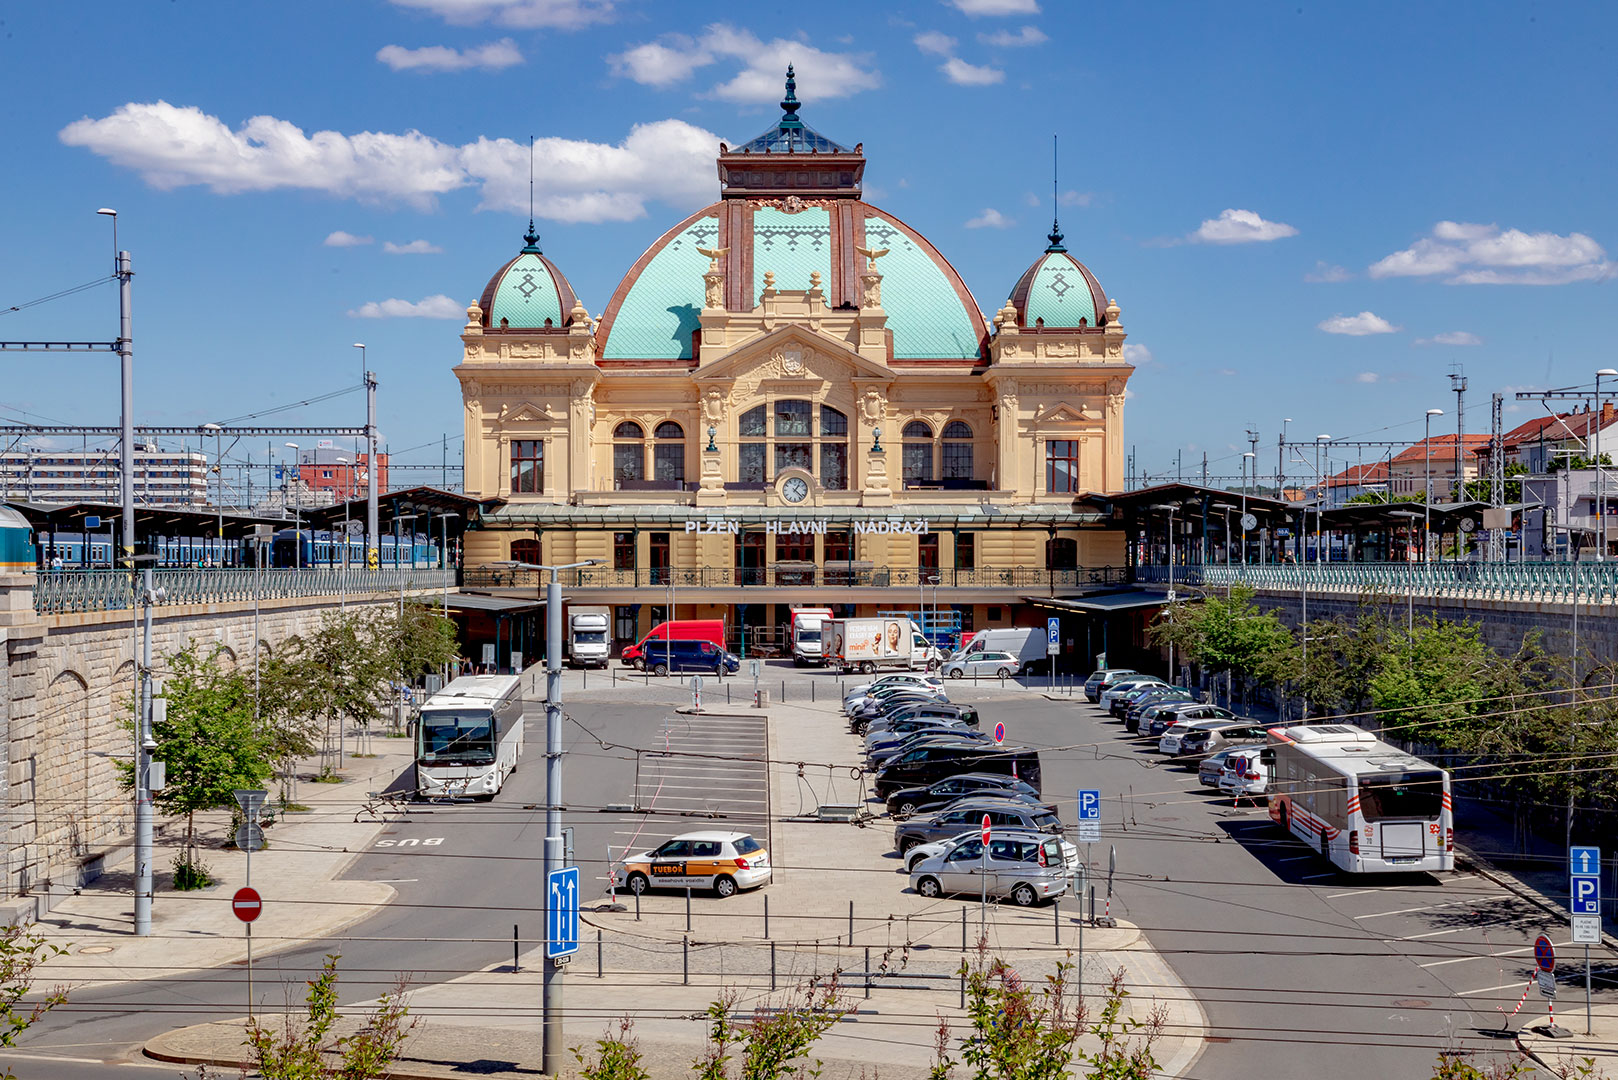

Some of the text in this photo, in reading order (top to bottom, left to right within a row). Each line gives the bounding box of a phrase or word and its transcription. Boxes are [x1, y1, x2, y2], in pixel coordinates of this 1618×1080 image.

[685, 518, 929, 535] PLZEŇ HLAVNÍ NÁDRAŽÍ
[1082, 793, 1096, 811] P
[375, 838, 445, 847] BUS
[652, 865, 683, 873] TUEBOR
[1578, 880, 1595, 902] P
